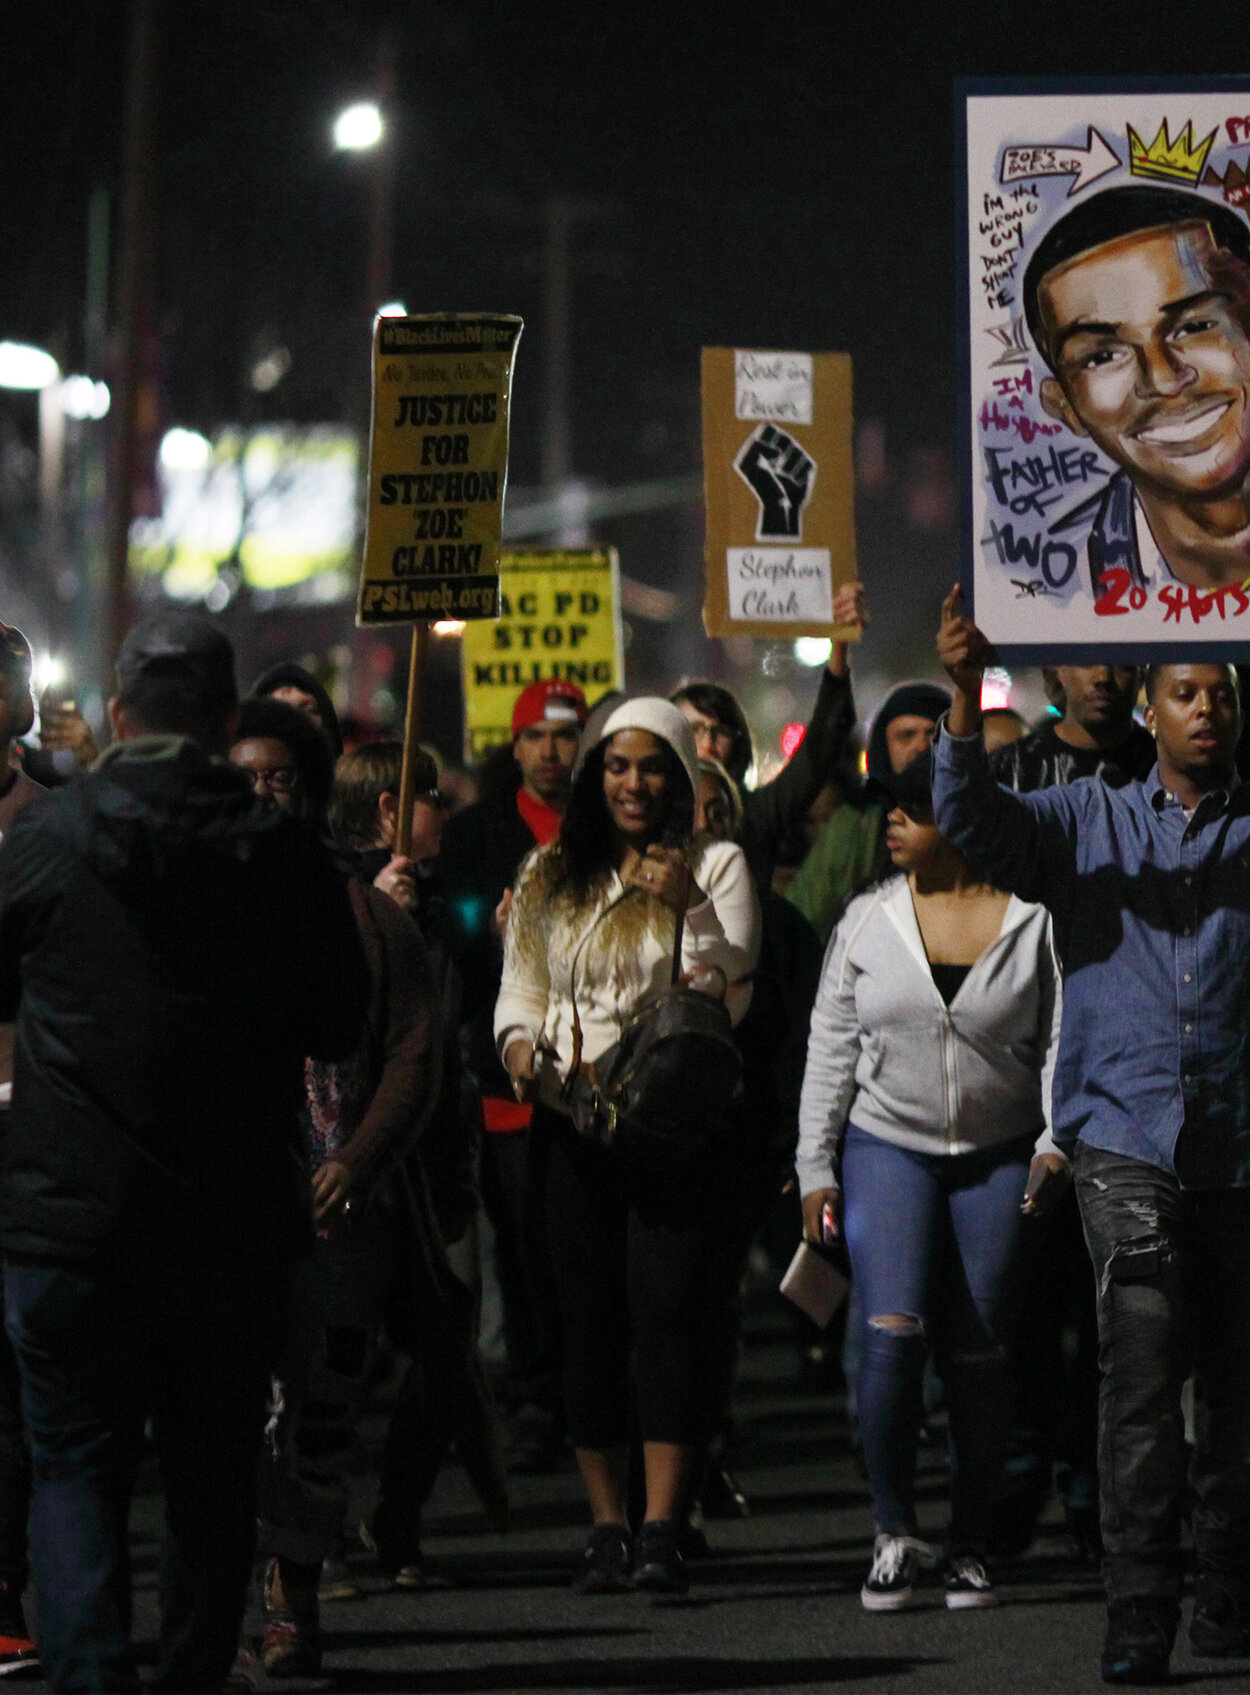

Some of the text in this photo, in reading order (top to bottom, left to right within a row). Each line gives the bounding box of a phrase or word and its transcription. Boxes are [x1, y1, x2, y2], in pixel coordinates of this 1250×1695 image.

[980, 201, 1037, 234] WRONG
[991, 222, 1024, 248] GUY
[988, 288, 1015, 309] ME
[992, 368, 1033, 396] IM
[394, 393, 497, 427] JUSTICE
[1008, 395, 1024, 412] A
[421, 434, 469, 466] FOR
[380, 471, 498, 505] STEPHON
[392, 544, 481, 577] CLARK!
[740, 551, 824, 586] Stephon
[363, 582, 495, 614] PSLweb.org
[556, 591, 599, 616] PD
[742, 590, 800, 616] Clark
[1094, 568, 1147, 617] 20
[1158, 582, 1249, 624] SHOTS
[495, 625, 588, 649] STOP
[475, 662, 611, 686] KILLING
